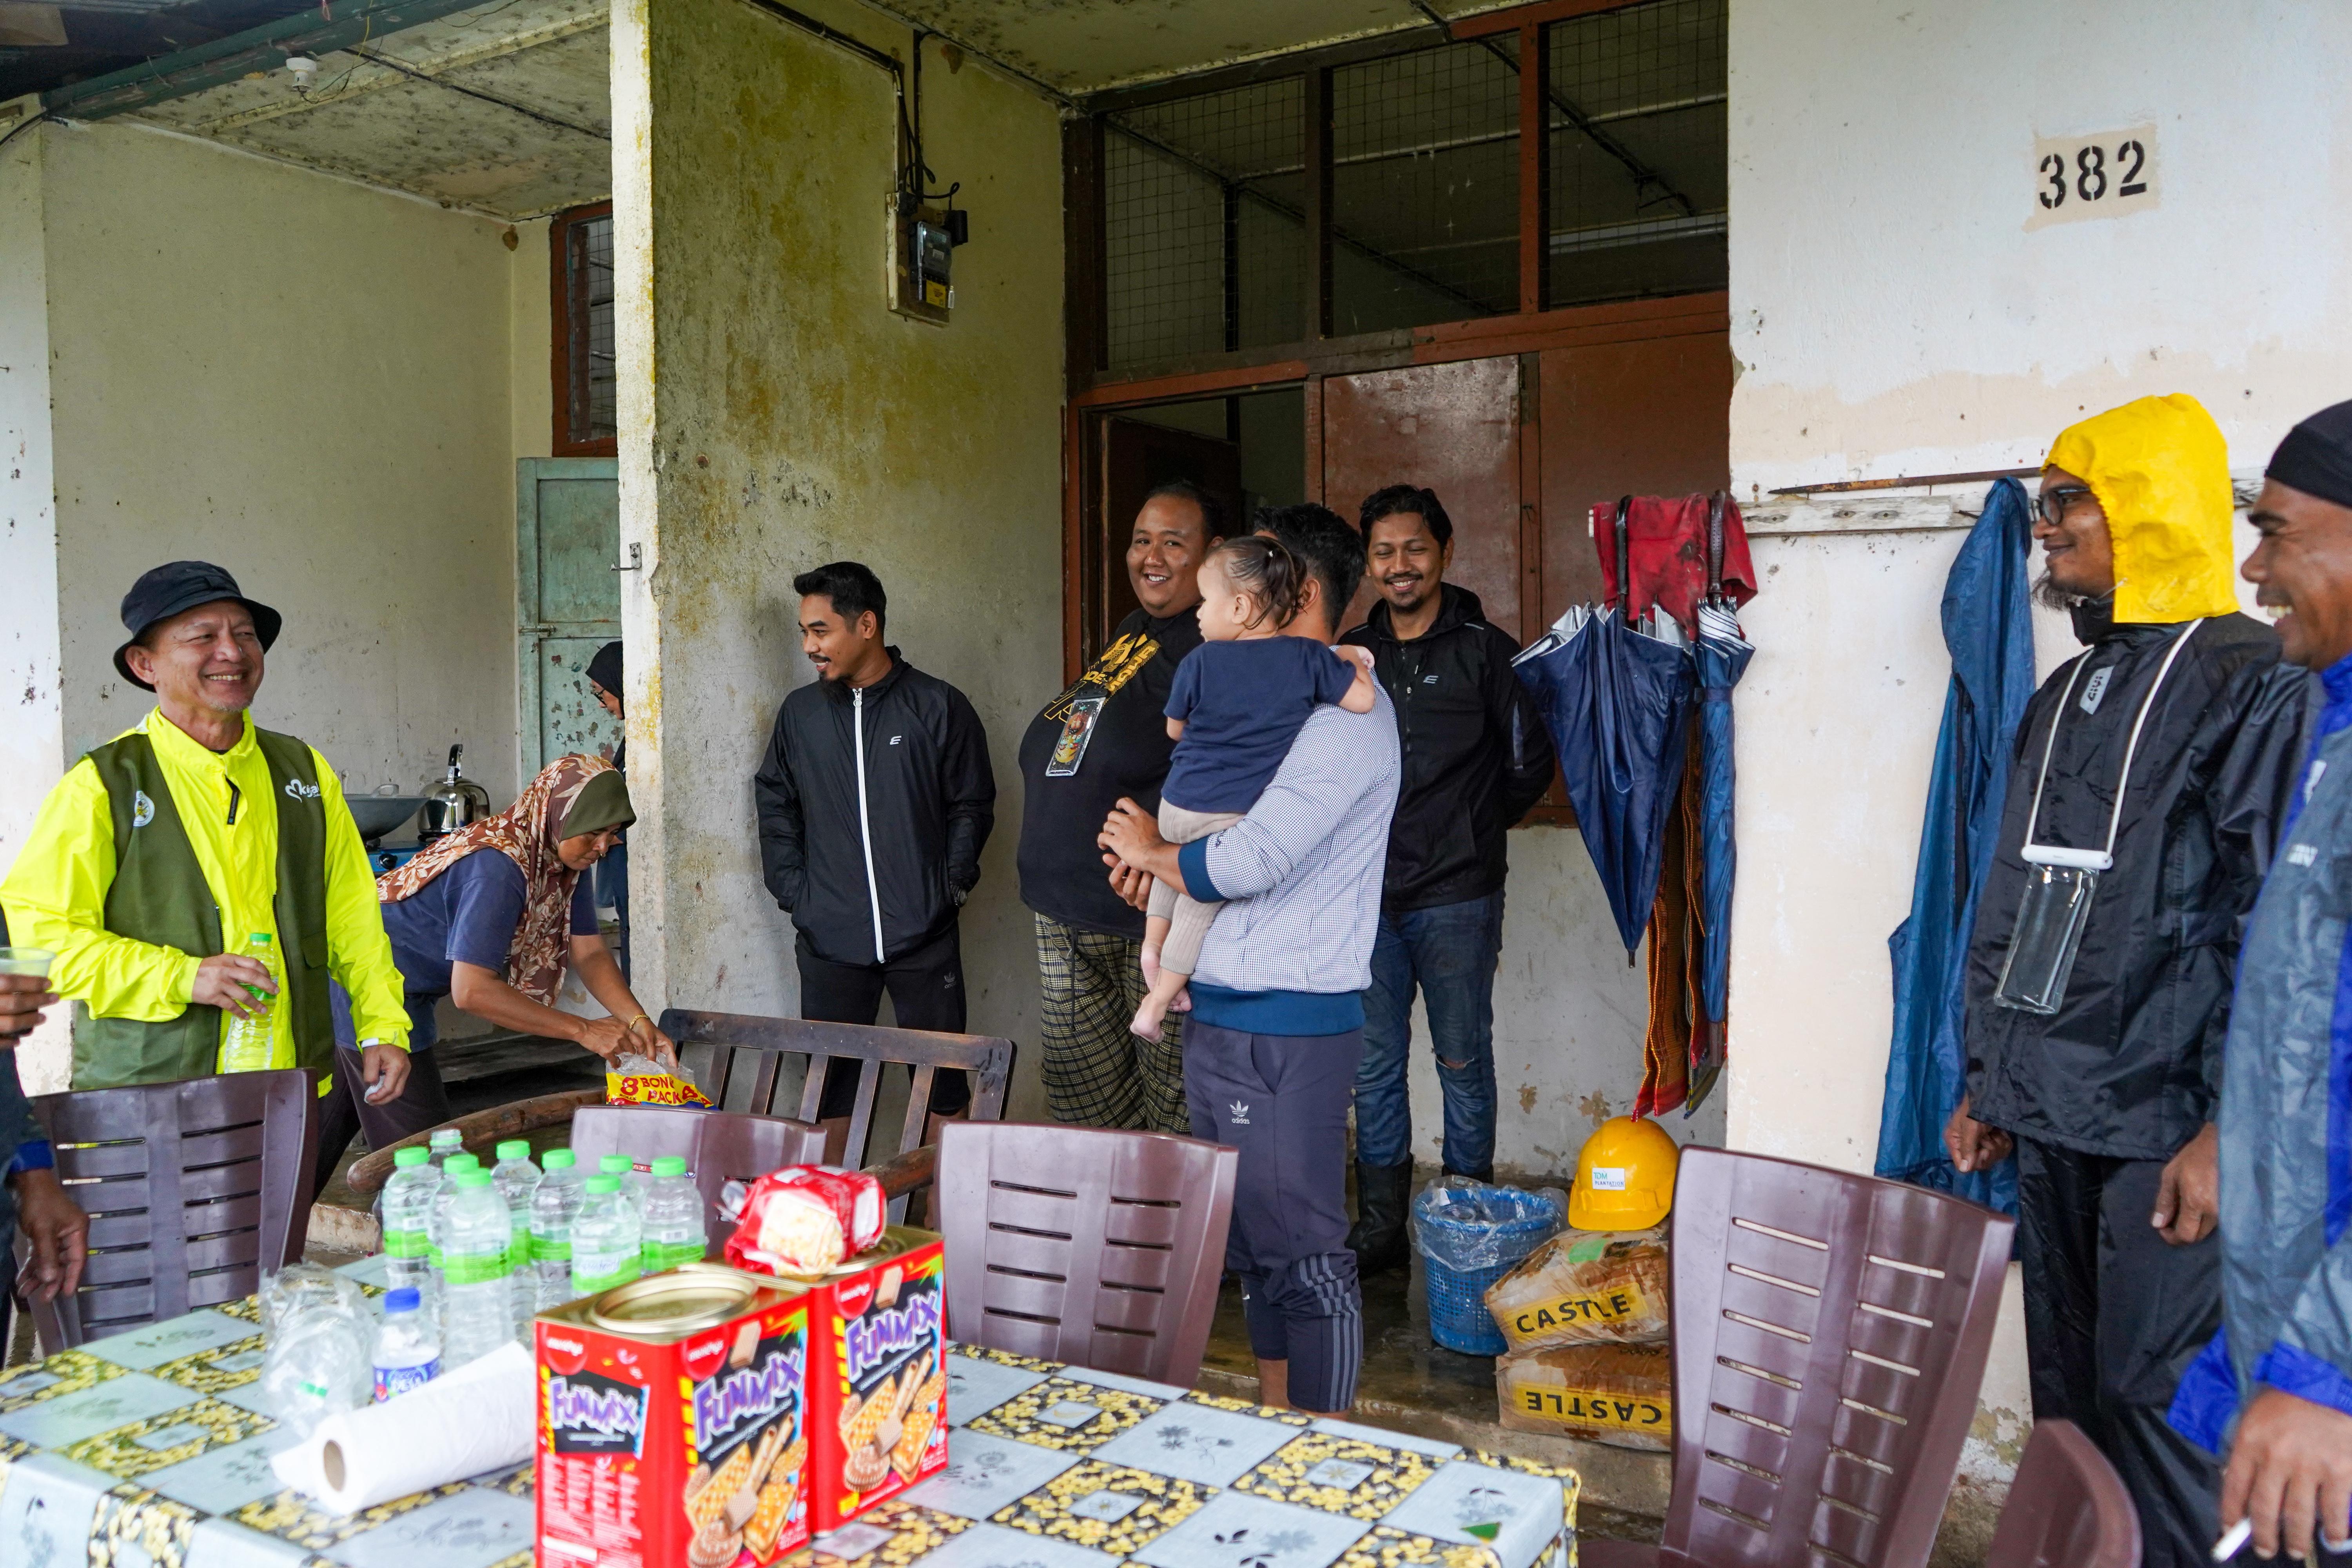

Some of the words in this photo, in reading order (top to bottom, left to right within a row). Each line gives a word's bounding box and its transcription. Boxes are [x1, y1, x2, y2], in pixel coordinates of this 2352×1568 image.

[2040, 139, 2147, 209] 382
[621, 1077, 638, 1096] 8
[648, 1090, 682, 1104] PACK
[1516, 1294, 1631, 1333] CASTLE
[845, 1290, 940, 1383] FUNMIX
[693, 1348, 804, 1452] FUNMIX
[1526, 1391, 1662, 1424] CASTLE
